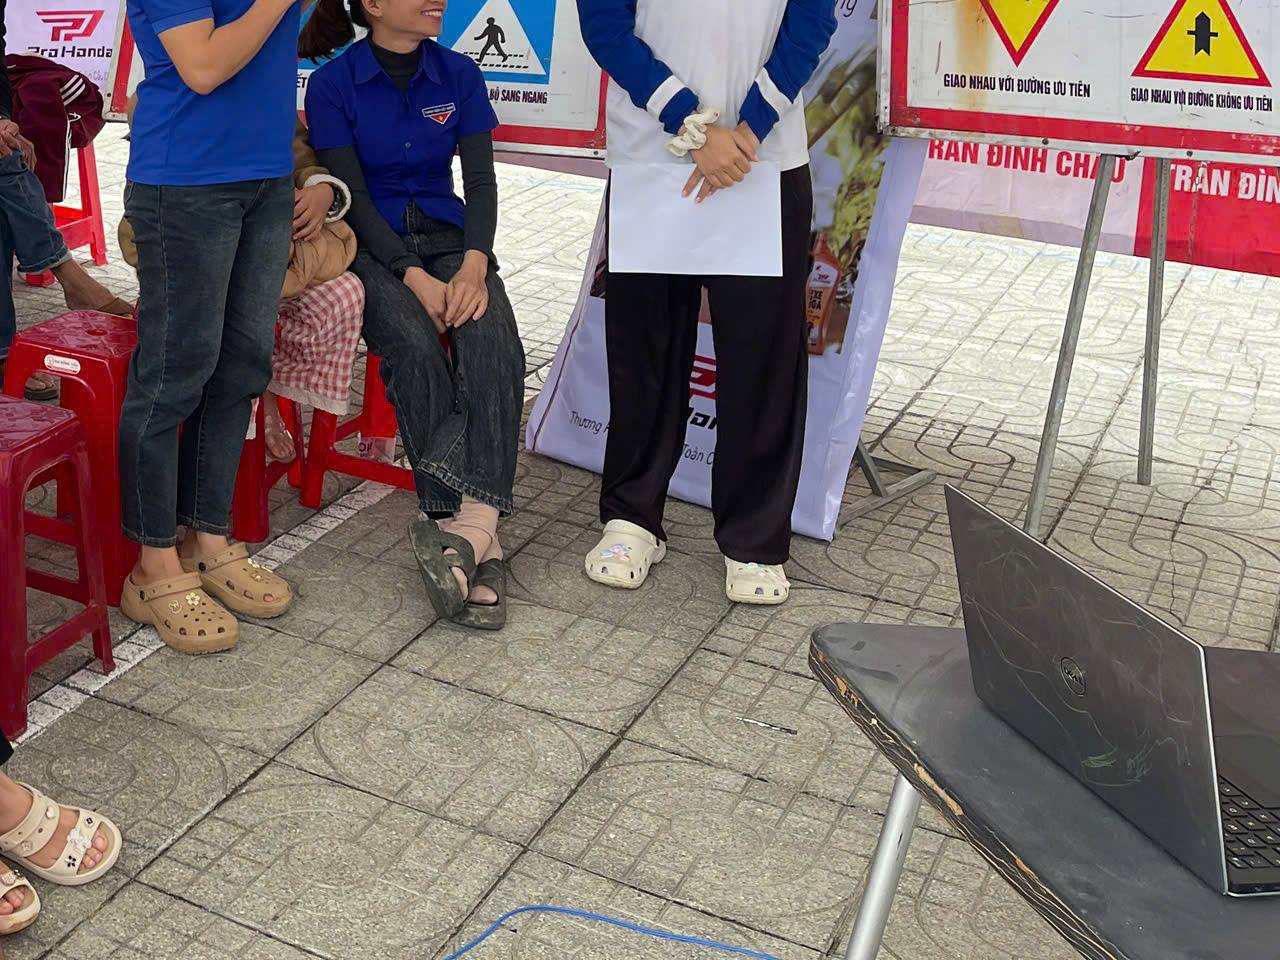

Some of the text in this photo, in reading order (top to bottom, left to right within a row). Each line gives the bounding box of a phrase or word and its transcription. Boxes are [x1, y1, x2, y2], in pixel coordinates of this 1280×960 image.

[501, 90, 520, 102] SANG
[522, 91, 548, 104] NGANG
[944, 73, 1091, 98] GIAO NHAU VỚI ĐƯỜNG ƯU TIÊN
[1130, 88, 1149, 102] GIAO
[1151, 89, 1171, 104] NHAU
[1216, 91, 1242, 109] KHÔNG
[1243, 96, 1254, 110] ƯU
[1256, 94, 1273, 111] TIÊN
[1170, 161, 1280, 202] RẦN ĐÌN
[570, 410, 603, 435] Thương
